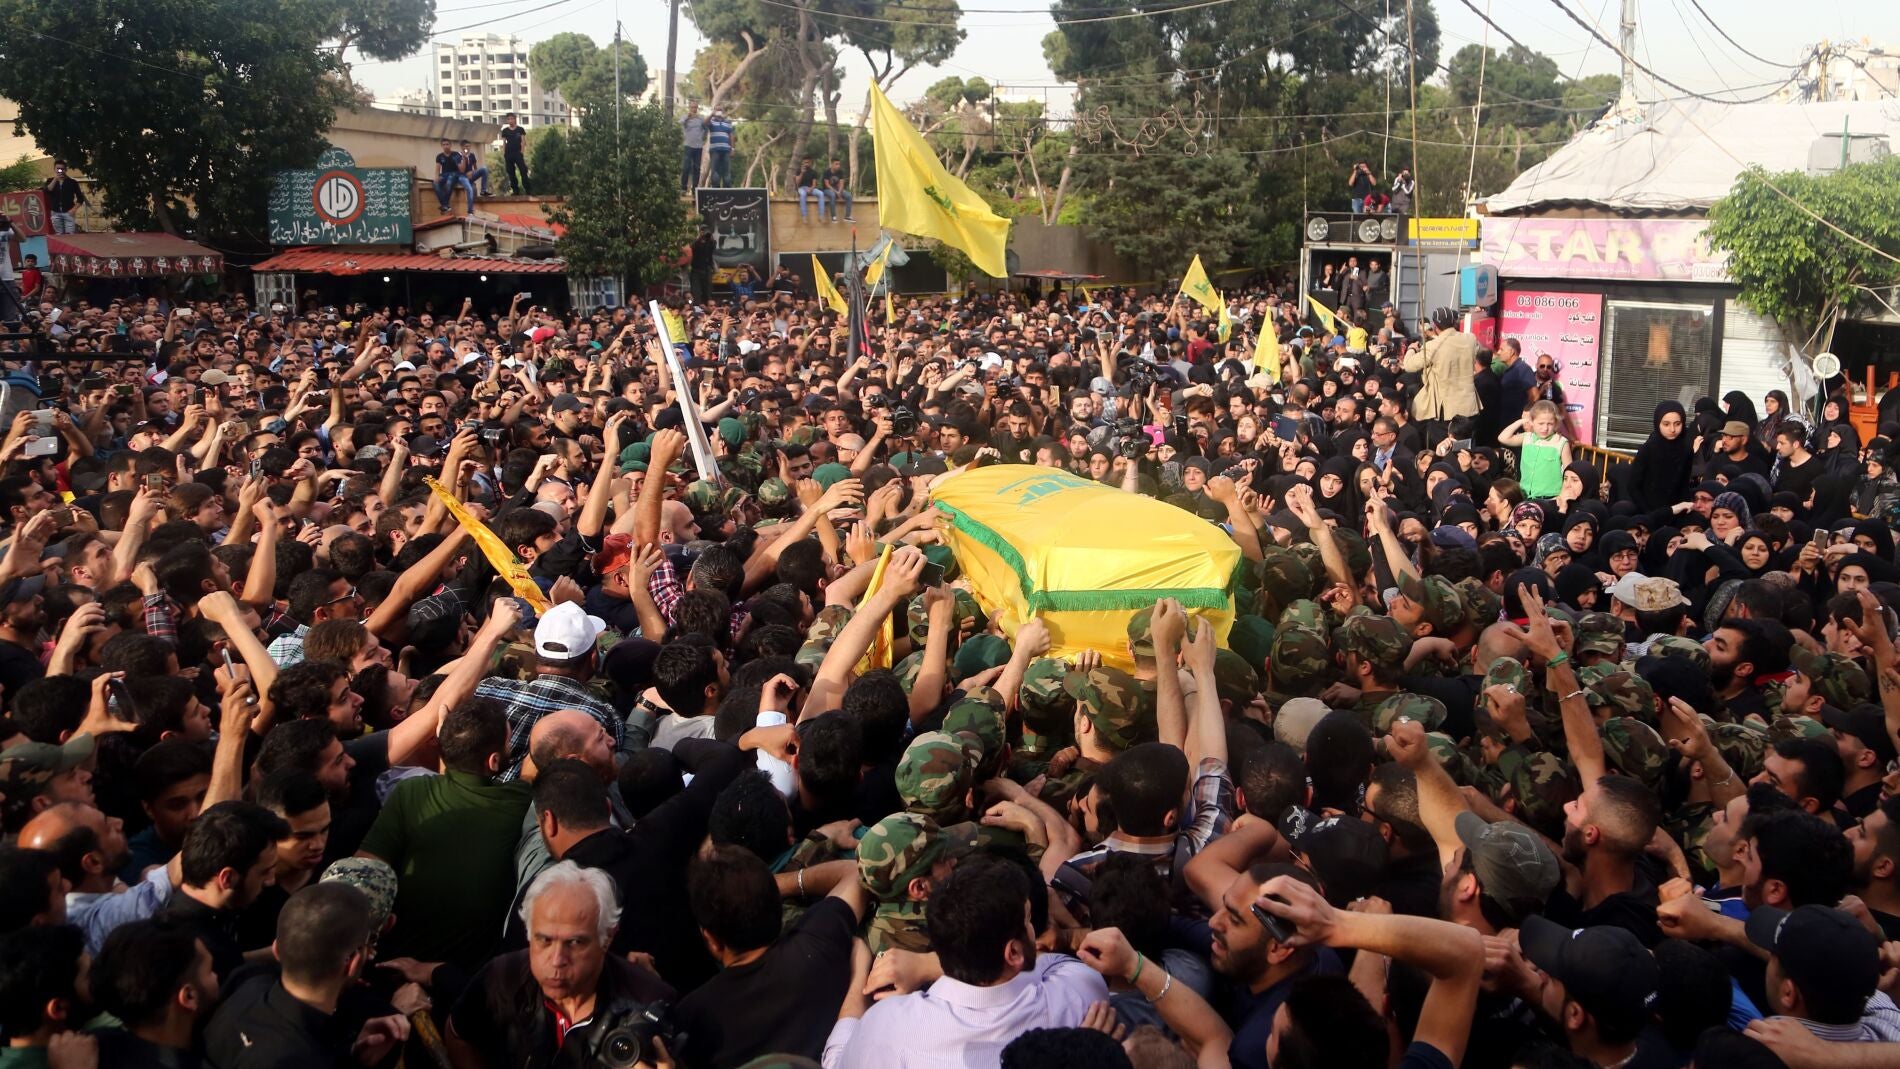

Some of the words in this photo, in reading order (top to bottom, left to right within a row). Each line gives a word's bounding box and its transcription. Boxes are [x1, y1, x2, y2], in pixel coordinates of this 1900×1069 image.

[1489, 228, 1645, 264] STAR
[1517, 296, 1531, 306] 03
[1534, 297, 1555, 307] 086
[1558, 298, 1579, 308] 066
